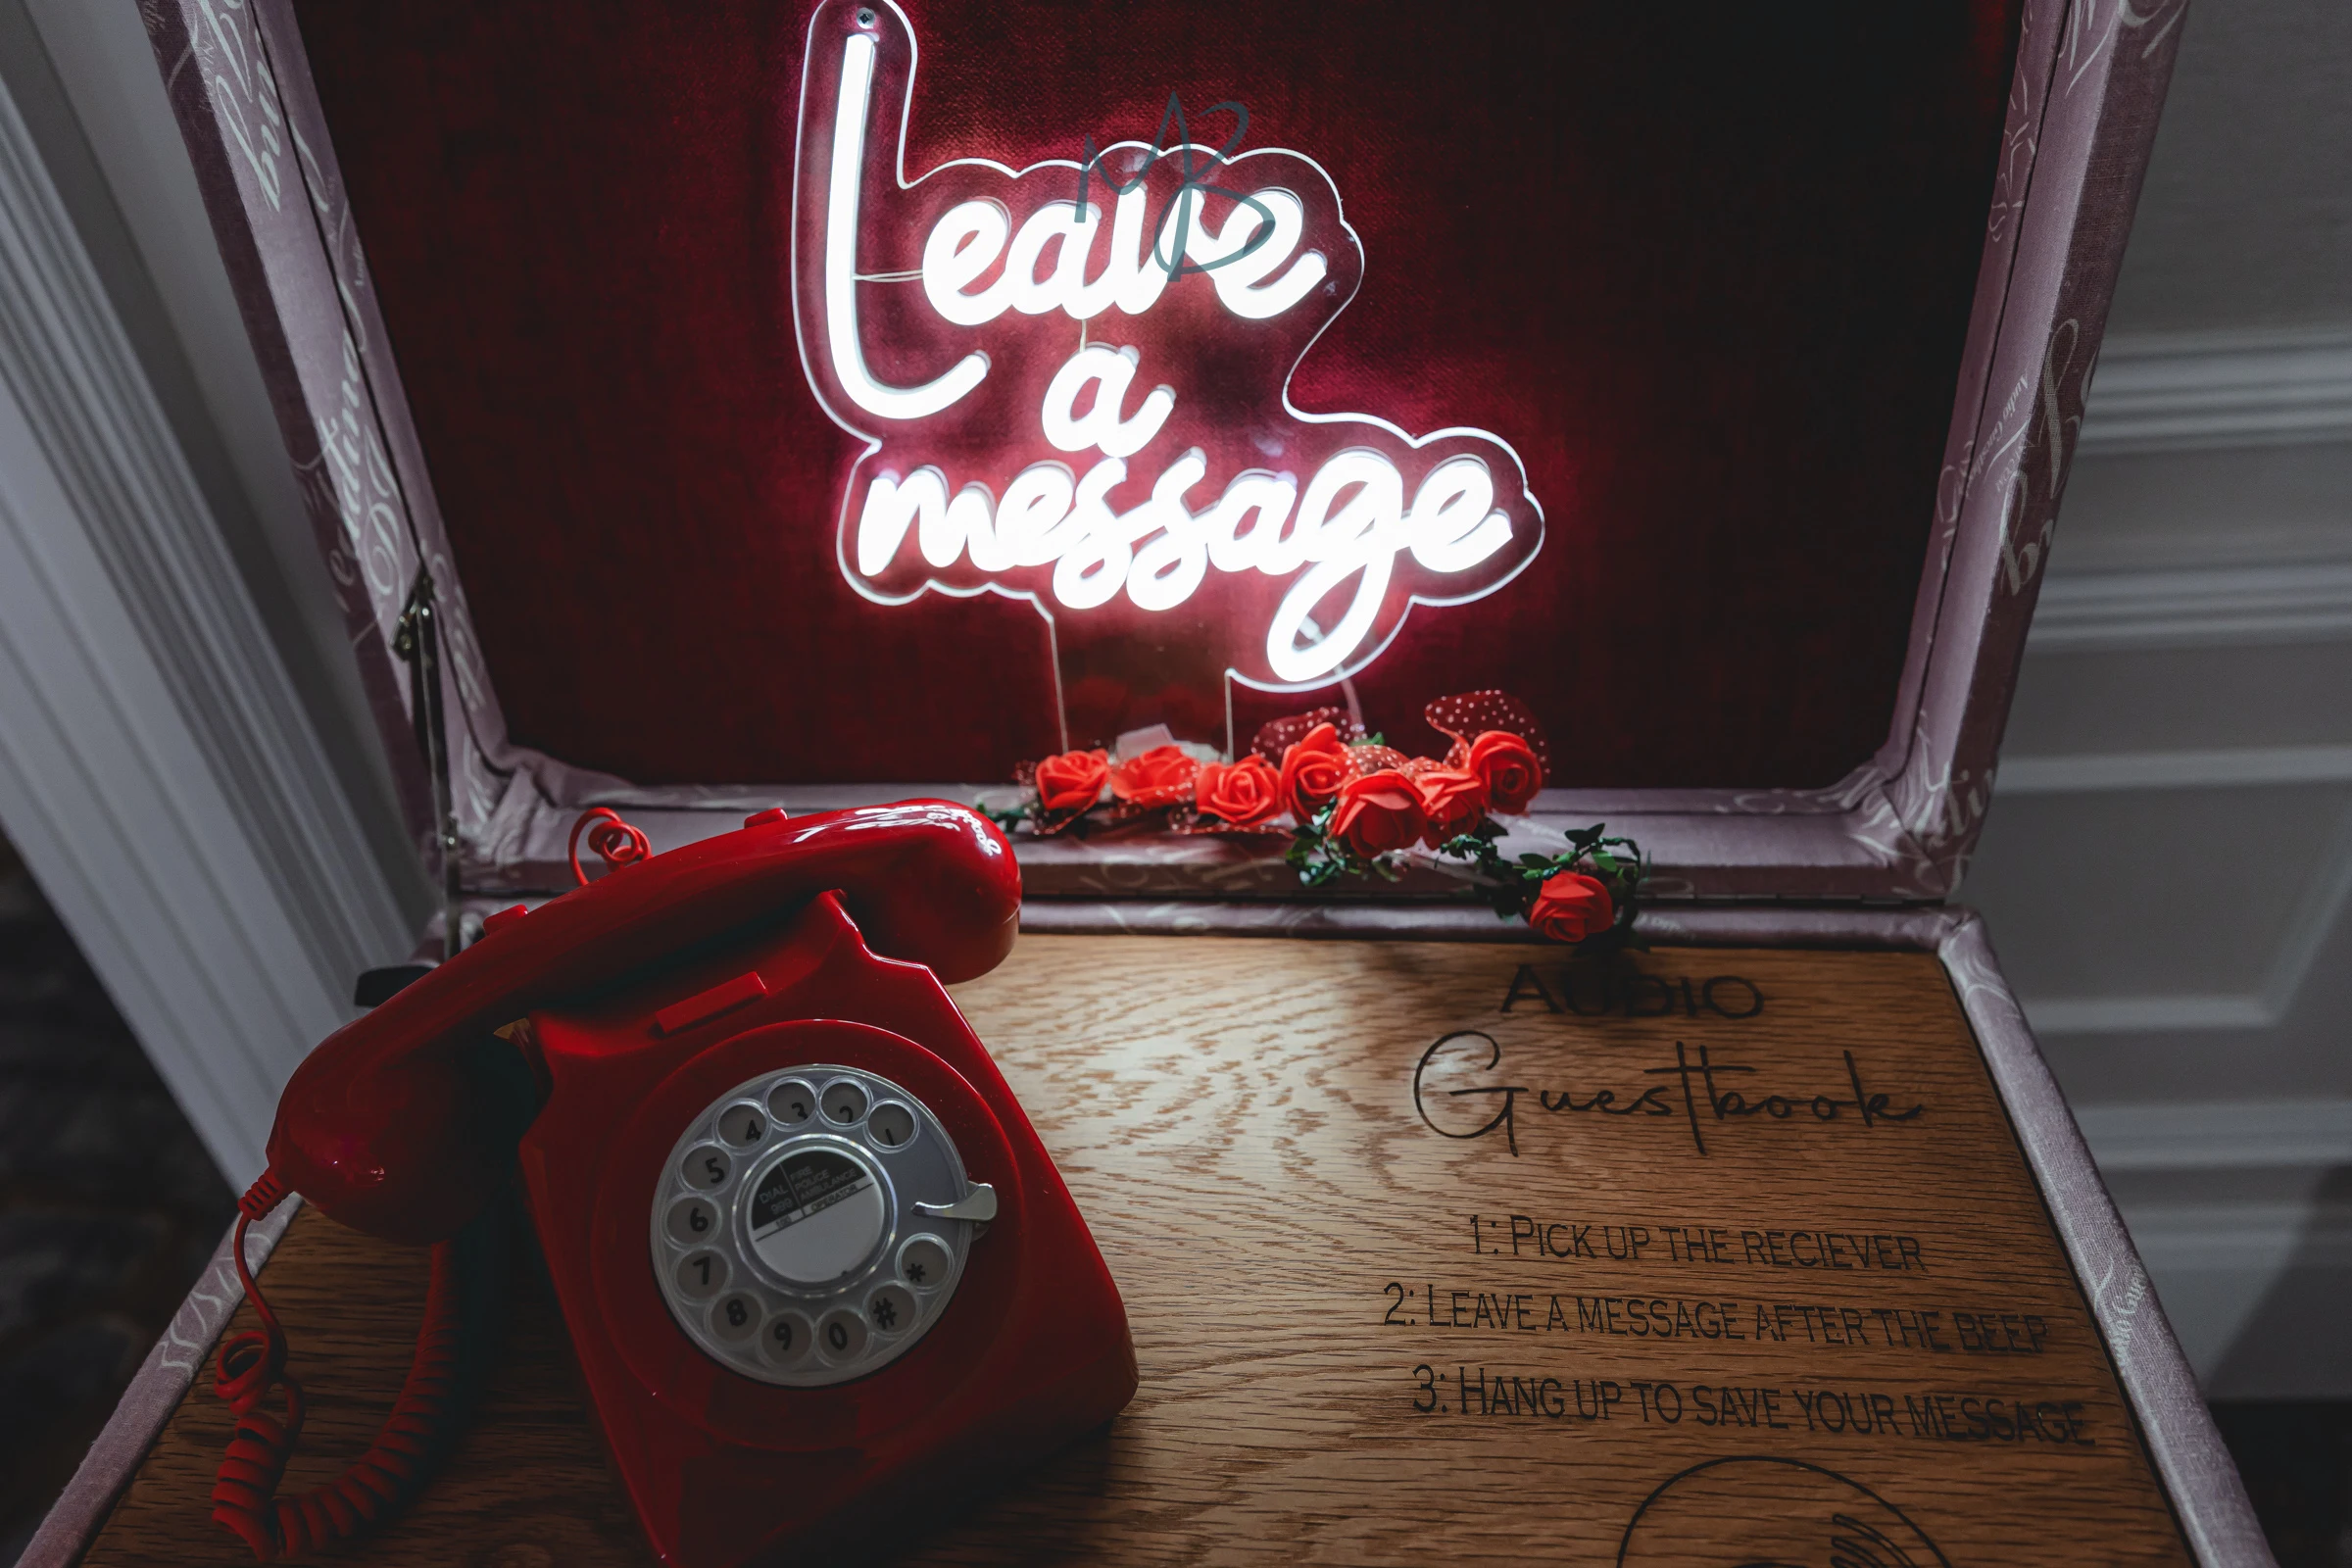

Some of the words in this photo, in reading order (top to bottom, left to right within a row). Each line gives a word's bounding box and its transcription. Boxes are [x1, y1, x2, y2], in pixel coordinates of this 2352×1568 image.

[825, 31, 1329, 419] Leave
[1041, 343, 1175, 458] a
[858, 446, 1515, 683] message
[1413, 1029, 1925, 1157] Guestbook
[745, 1119, 761, 1143] 4
[705, 1156, 725, 1184] 5
[794, 1168, 830, 1192] POLICE
[759, 1184, 790, 1204] DIAL
[689, 1206, 710, 1233] 6
[1469, 1215, 1499, 1256] 1:
[1509, 1215, 1596, 1260] PICK
[1603, 1223, 1651, 1260] UP
[1661, 1225, 1734, 1266] THE
[1741, 1230, 1927, 1273] RECIEVER
[692, 1256, 711, 1285] 7
[725, 1298, 748, 1327] 8
[1383, 1282, 1416, 1327] 2:
[1427, 1284, 1538, 1332] LEAVE
[1545, 1294, 1572, 1332] A
[1577, 1295, 1747, 1342] MESSAGE
[1755, 1301, 1870, 1347] AFTER
[1874, 1308, 1950, 1350] THE
[1955, 1313, 2048, 1354] BEEP
[773, 1323, 793, 1350] 9
[1412, 1364, 1447, 1415] 3:
[1459, 1365, 1566, 1419] HANG
[1574, 1380, 1624, 1421] UP
[1636, 1382, 1684, 1425] TO
[1693, 1384, 1790, 1431] SAVE
[1794, 1390, 1906, 1437] YOUR
[1907, 1395, 2097, 1448] MESSAGE
